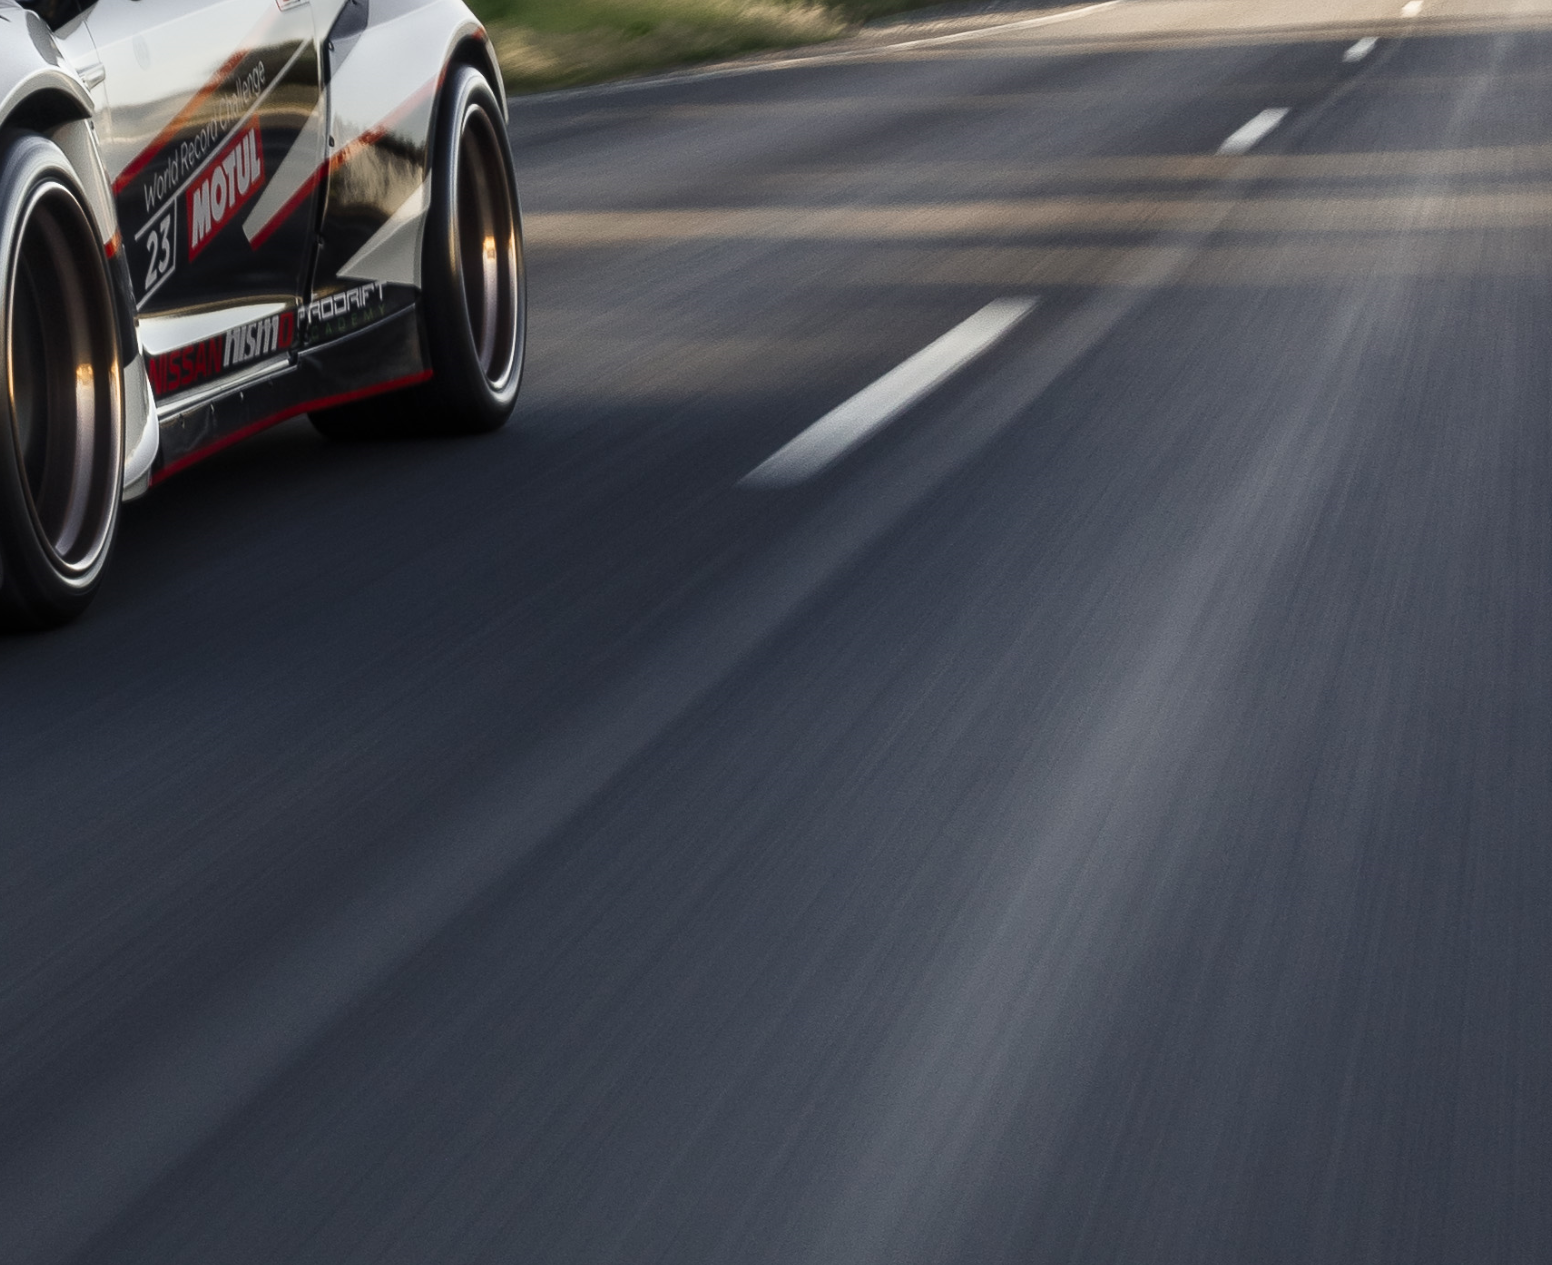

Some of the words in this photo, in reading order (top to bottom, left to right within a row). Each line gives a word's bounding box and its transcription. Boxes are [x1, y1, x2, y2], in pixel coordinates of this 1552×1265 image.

[144, 148, 179, 213] World
[181, 107, 218, 176] Record
[220, 61, 266, 131] Challenge
[191, 127, 261, 249] MOTUL
[145, 213, 171, 290] 23
[297, 281, 386, 329] PRODRIFT
[301, 304, 386, 343] CADEMY
[148, 334, 223, 396] NISSAN
